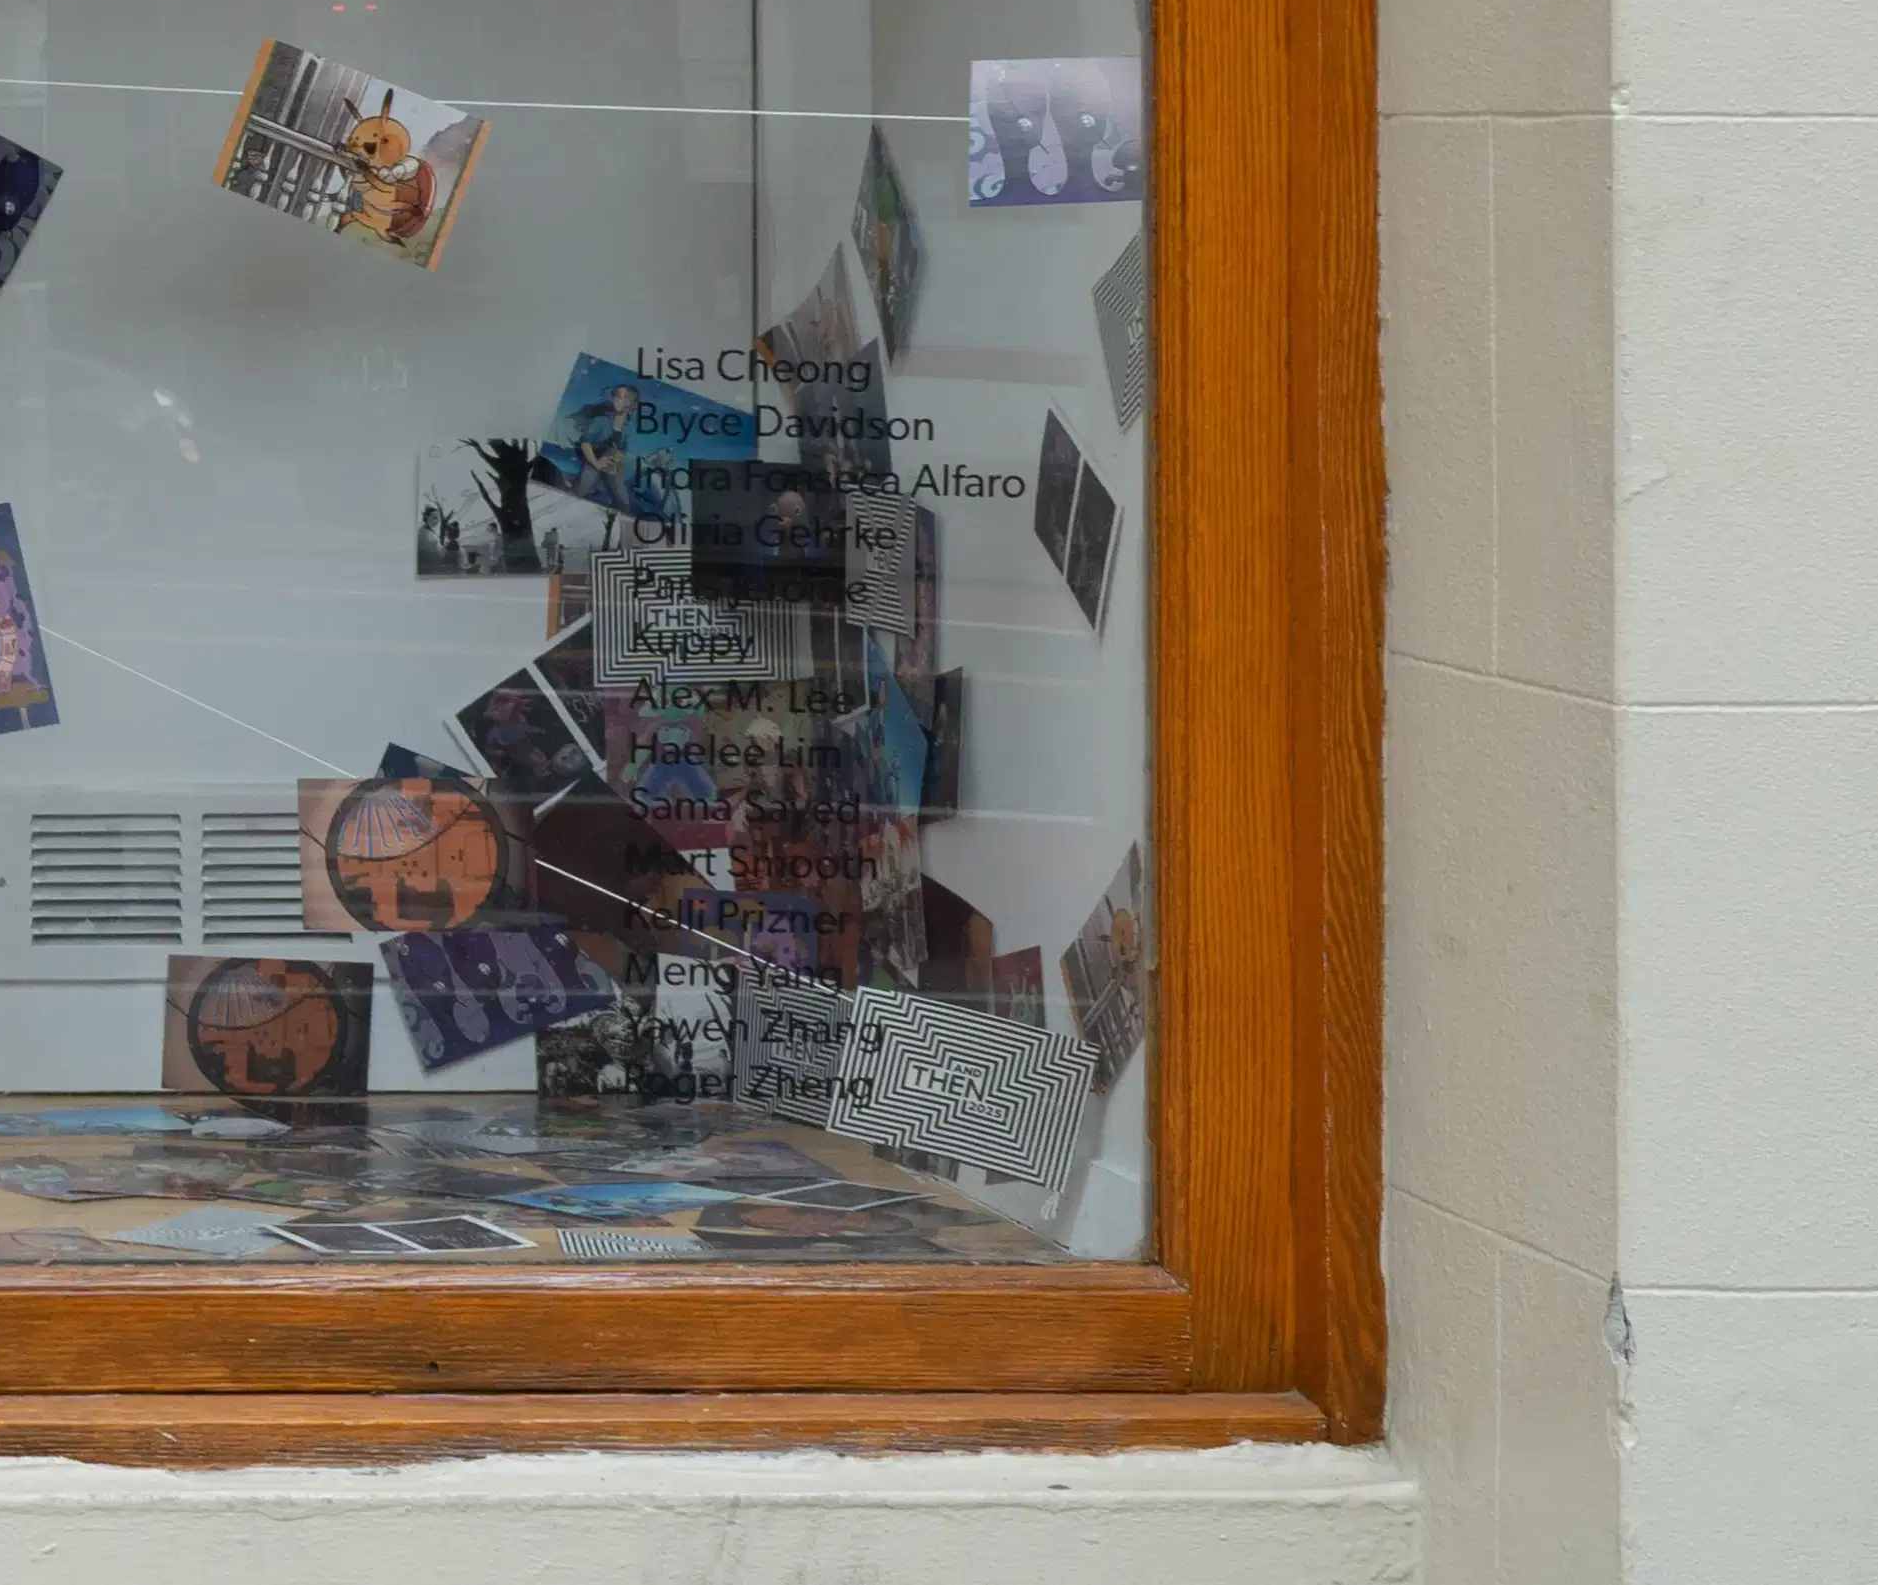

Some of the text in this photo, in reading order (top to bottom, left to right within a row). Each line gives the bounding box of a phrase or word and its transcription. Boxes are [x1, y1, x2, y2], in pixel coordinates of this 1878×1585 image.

[636, 346, 872, 392] Lisa Cheong
[636, 401, 934, 445] Bryce Davidson
[633, 460, 1026, 499] Indra Fonseca Alfaro
[632, 511, 899, 551] Olivia Gehrke
[650, 608, 714, 629] THEN
[629, 622, 754, 665] Kuppy
[628, 677, 713, 711] Alex
[728, 679, 773, 712] M.
[789, 681, 856, 715] Lee
[628, 732, 843, 769] Haelee Lim
[628, 787, 862, 828] Sama Sayed
[622, 842, 879, 881] Mart Smooth
[623, 897, 852, 935] Kelli Prizner
[624, 954, 844, 1001] Meng Yang
[624, 1008, 884, 1054] Yawen Zhang
[624, 1062, 876, 1109] Roger Zheng
[912, 1065, 984, 1103] THEN
[953, 1064, 983, 1078] AND
[968, 1101, 1003, 1119] 2025
